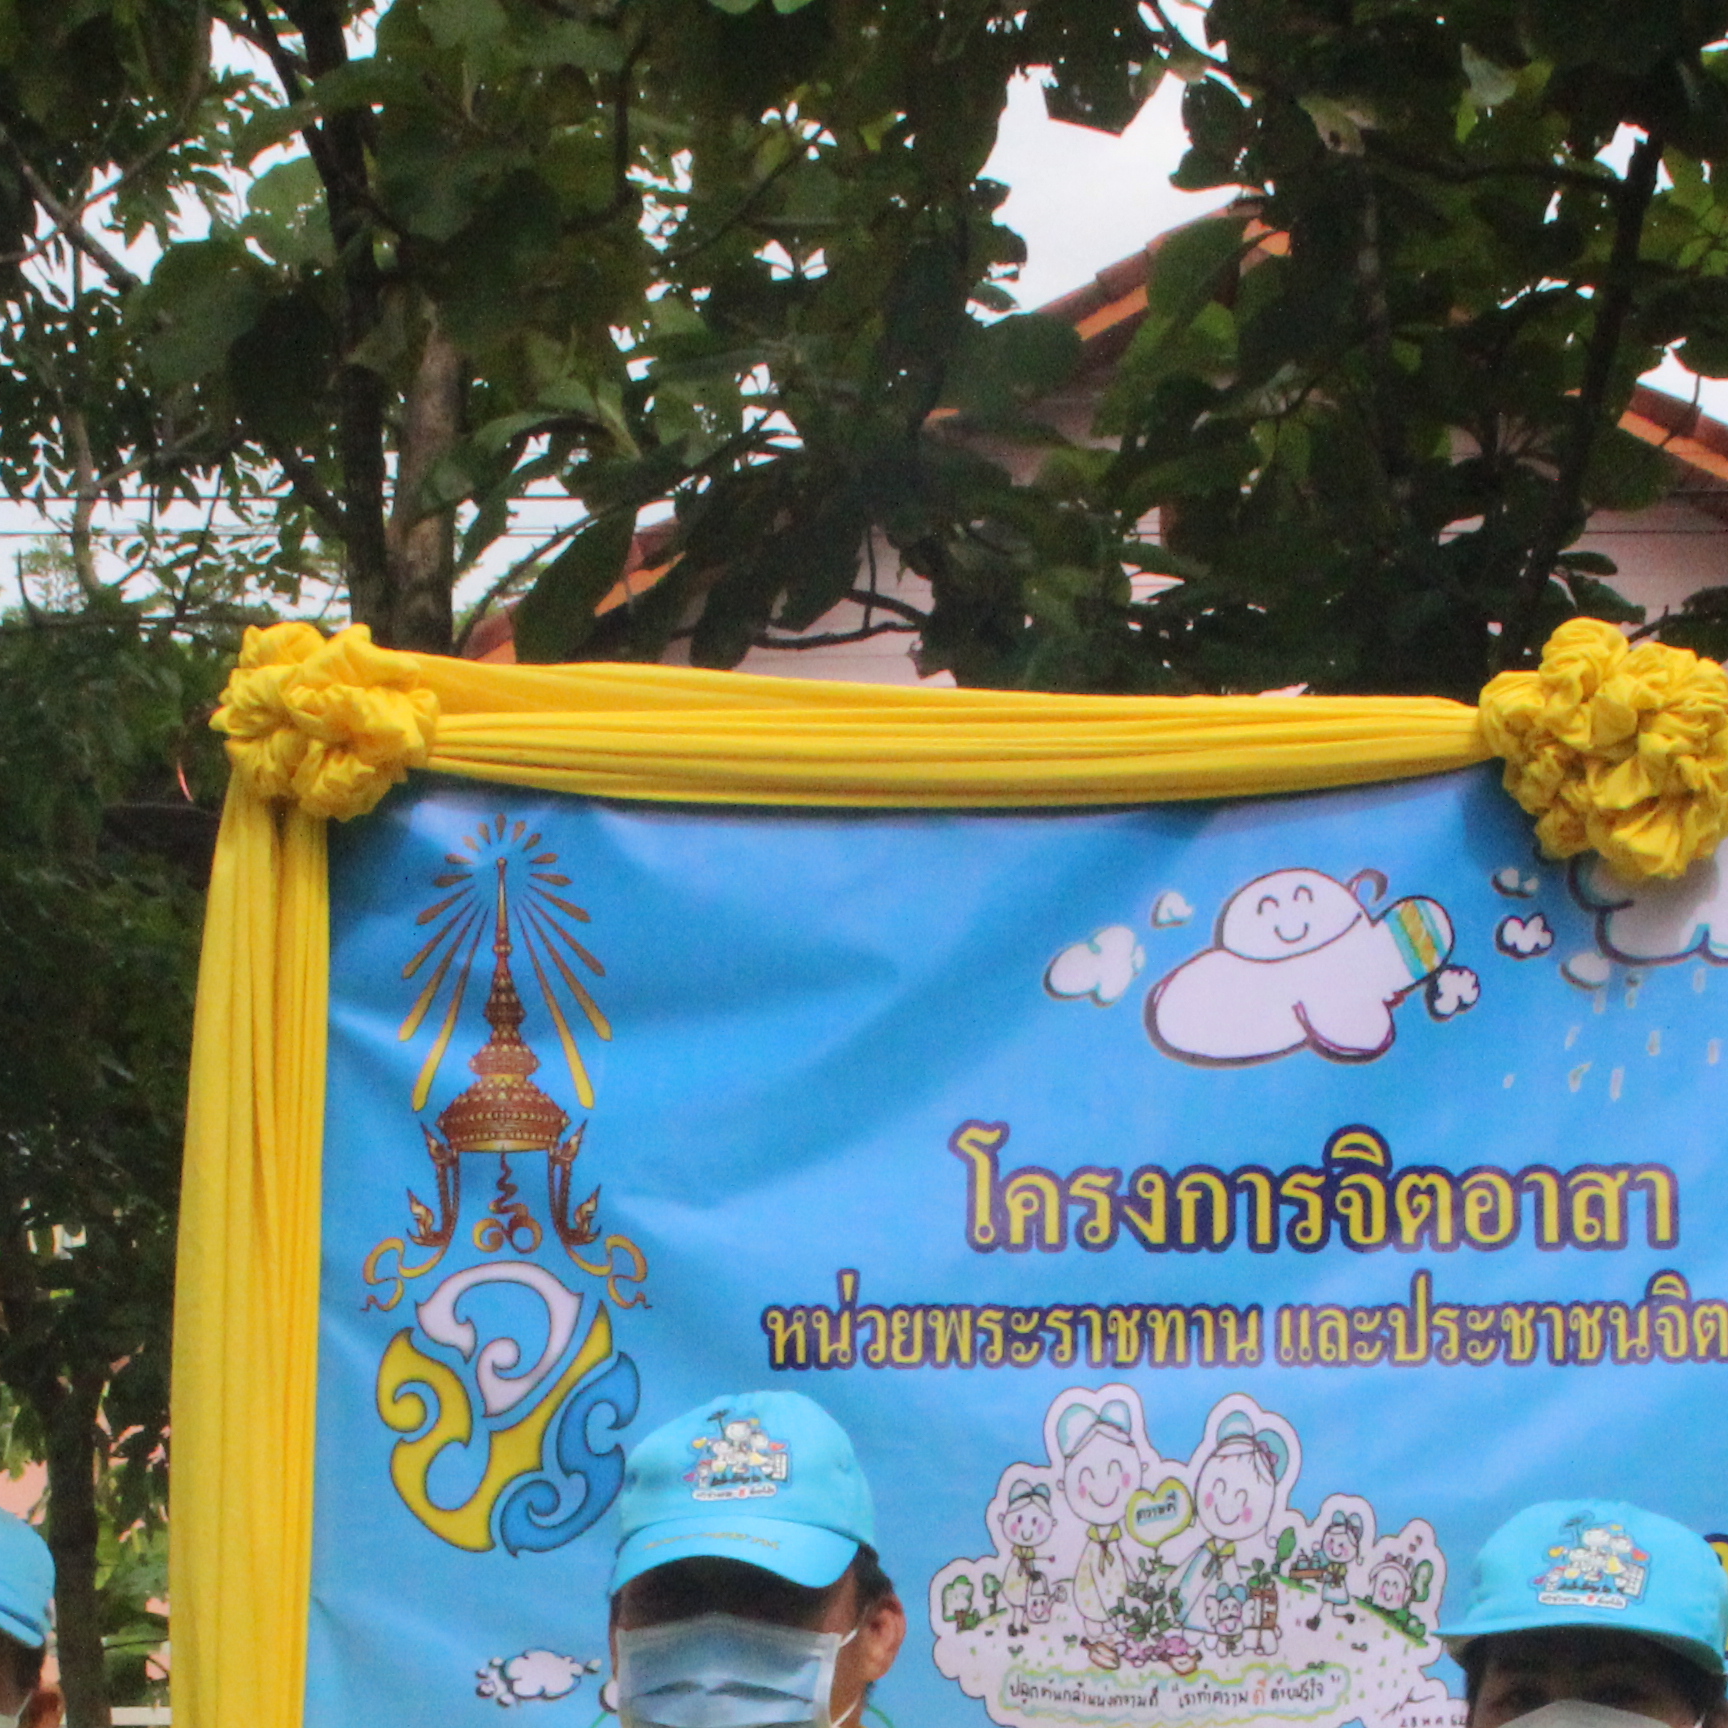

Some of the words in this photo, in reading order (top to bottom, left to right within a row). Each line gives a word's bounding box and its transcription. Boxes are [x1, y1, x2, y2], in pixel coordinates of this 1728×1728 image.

[949, 1119, 1678, 1254] โครงการจิตอาสา
[762, 1272, 1263, 1371] หน่วยพระราชทาน
